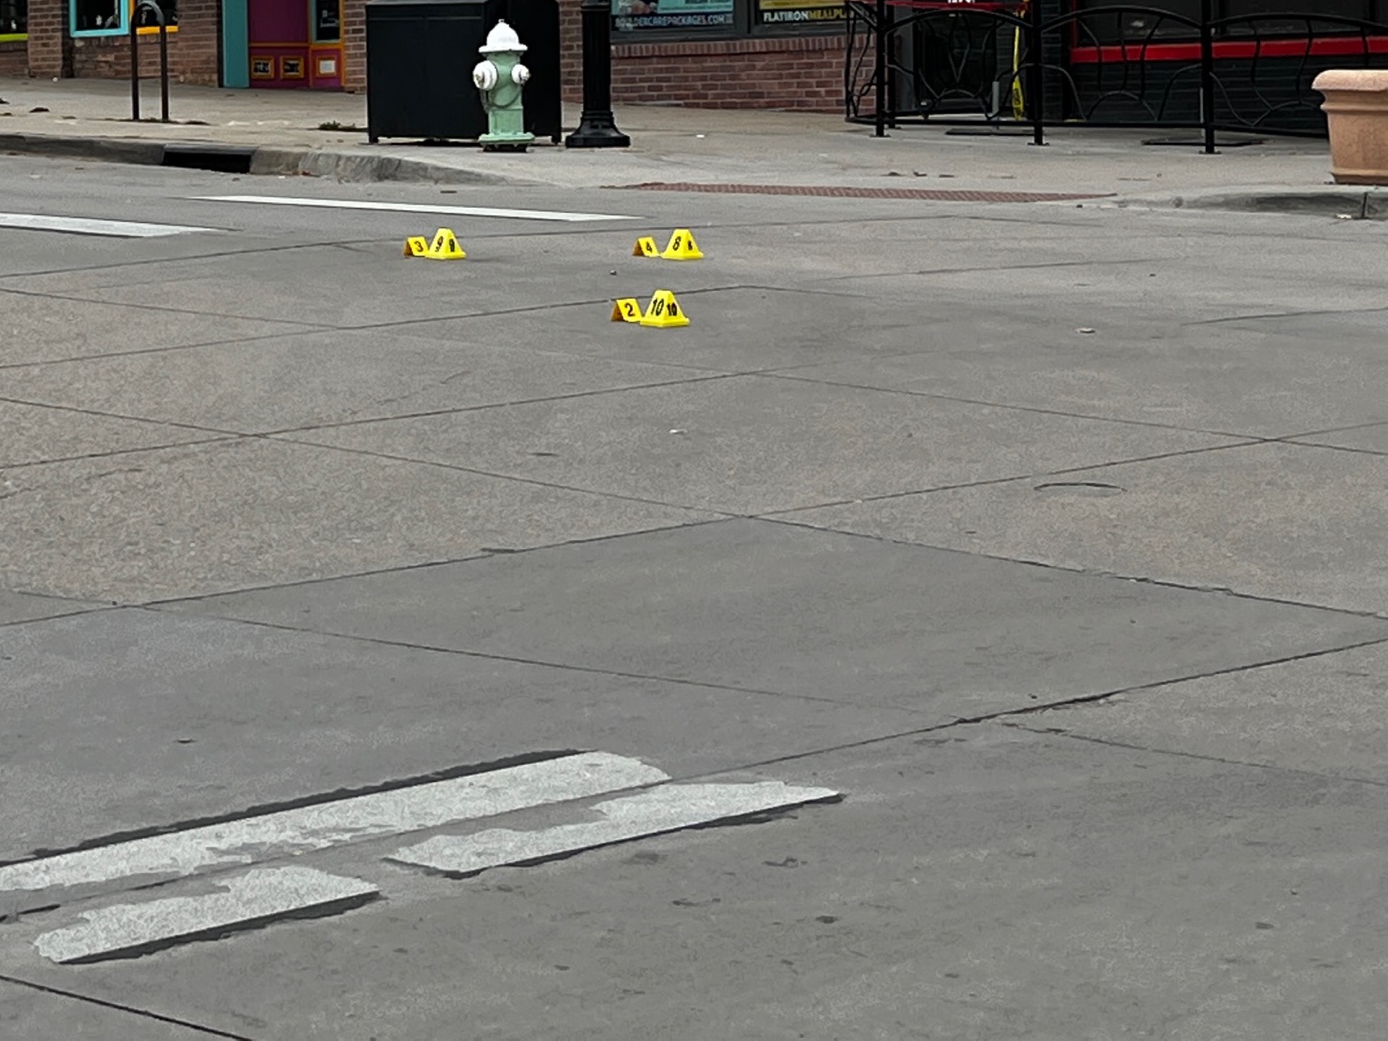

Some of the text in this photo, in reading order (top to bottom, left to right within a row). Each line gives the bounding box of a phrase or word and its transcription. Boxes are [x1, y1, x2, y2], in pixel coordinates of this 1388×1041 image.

[414, 240, 424, 252] 3
[435, 236, 444, 252] 9
[673, 236, 681, 251] 8
[625, 303, 636, 317] 2
[651, 298, 665, 316] 10
[667, 302, 678, 316] 10
